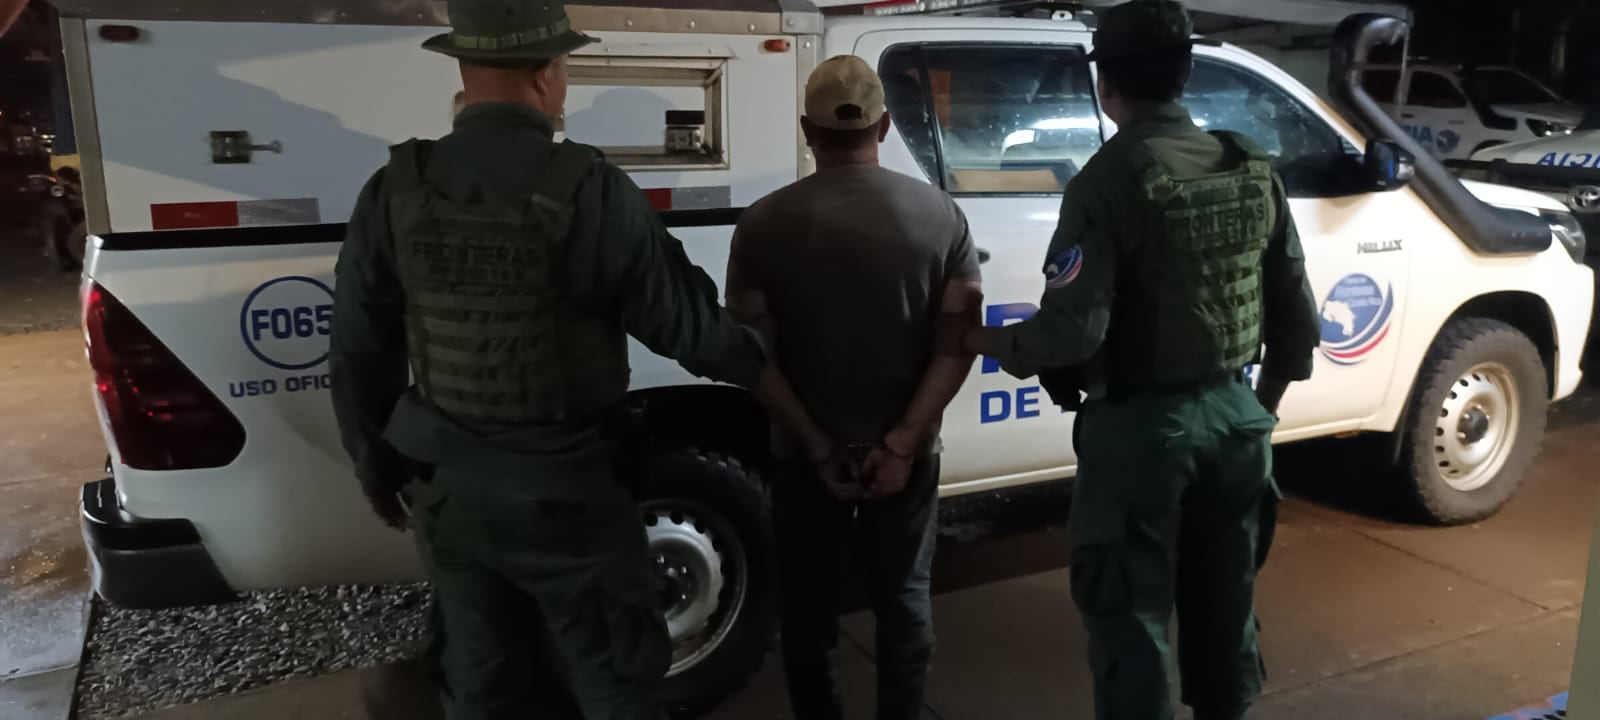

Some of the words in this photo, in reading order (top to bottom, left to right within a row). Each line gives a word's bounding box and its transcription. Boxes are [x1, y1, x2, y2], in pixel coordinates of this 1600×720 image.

[412, 239, 540, 267] FRONTERAS
[1356, 239, 1403, 255] HILUX
[229, 379, 277, 398] USO
[980, 386, 1040, 424] DE
